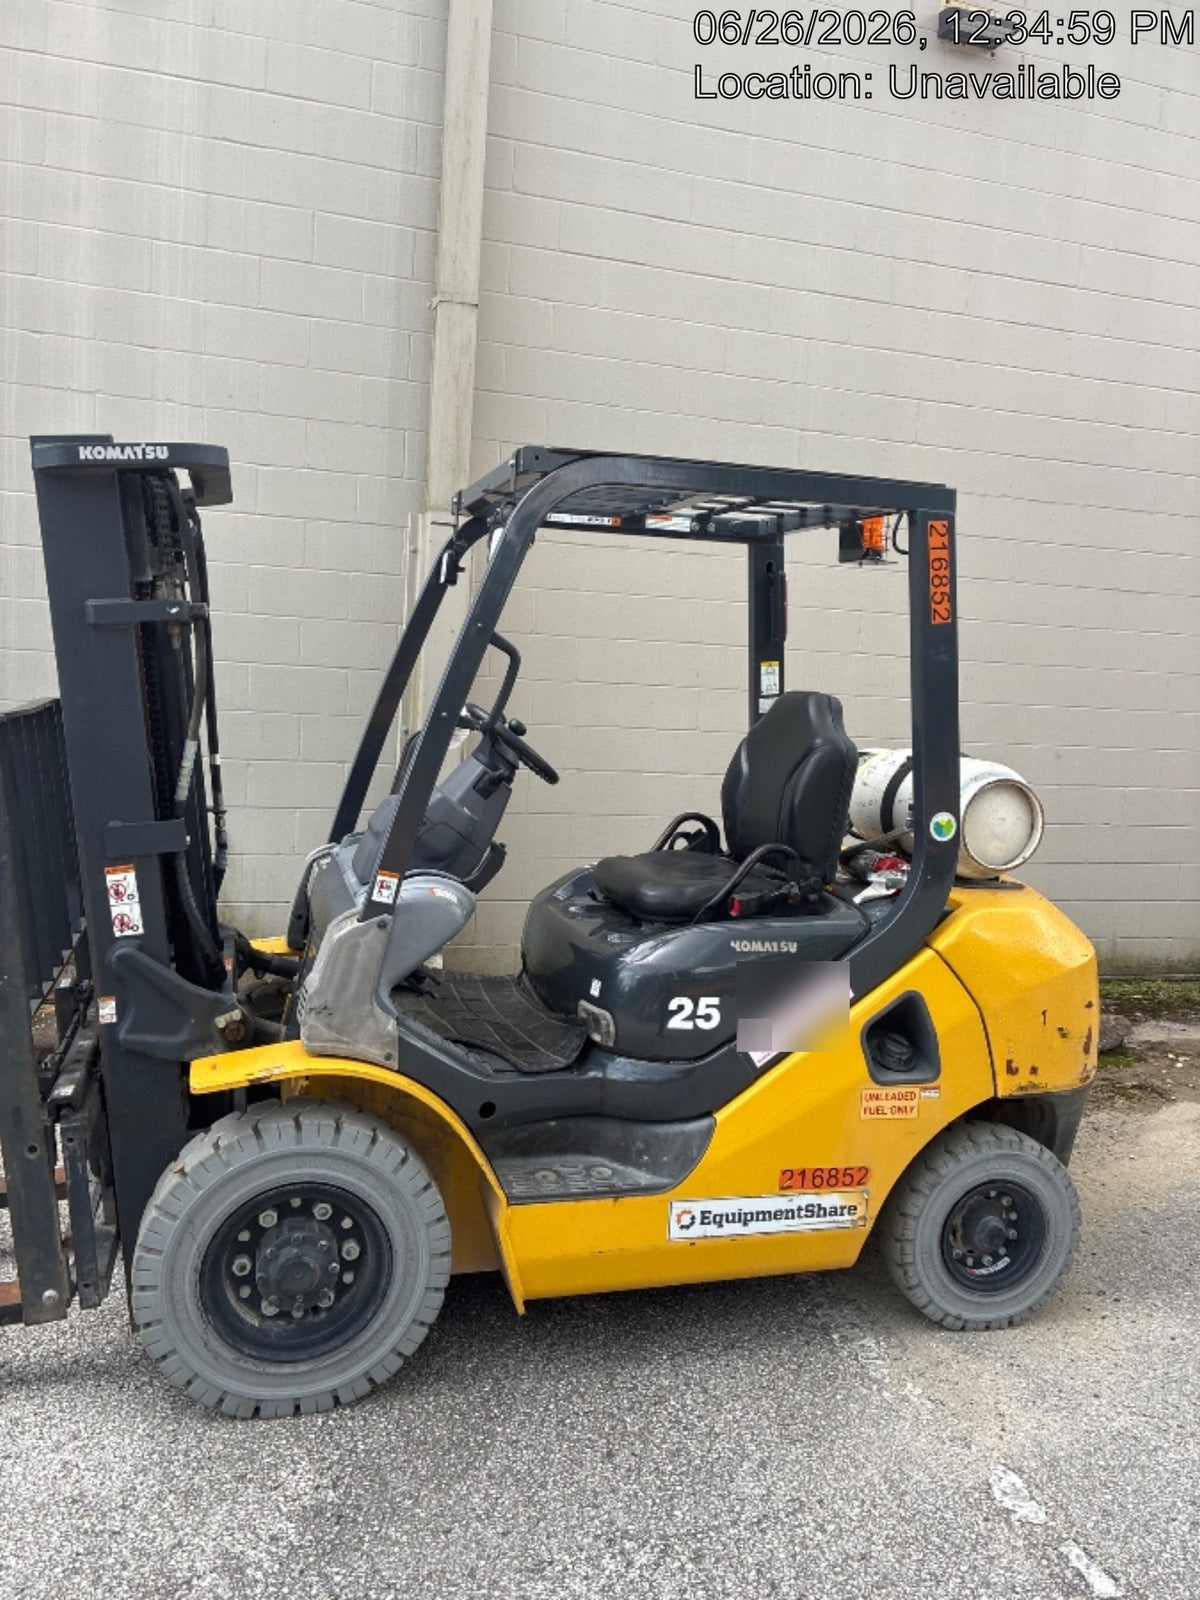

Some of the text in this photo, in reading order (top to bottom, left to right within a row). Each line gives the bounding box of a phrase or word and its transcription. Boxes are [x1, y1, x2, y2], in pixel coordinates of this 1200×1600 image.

[79, 444, 169, 460] KOMATSU
[929, 523, 951, 622] 216852
[667, 996, 721, 1030] 25
[864, 1091, 917, 1102] UNLEADED
[863, 1104, 916, 1116] FUEL ONLY
[780, 1166, 870, 1190] 216852
[699, 1202, 858, 1229] EquipmentShare
